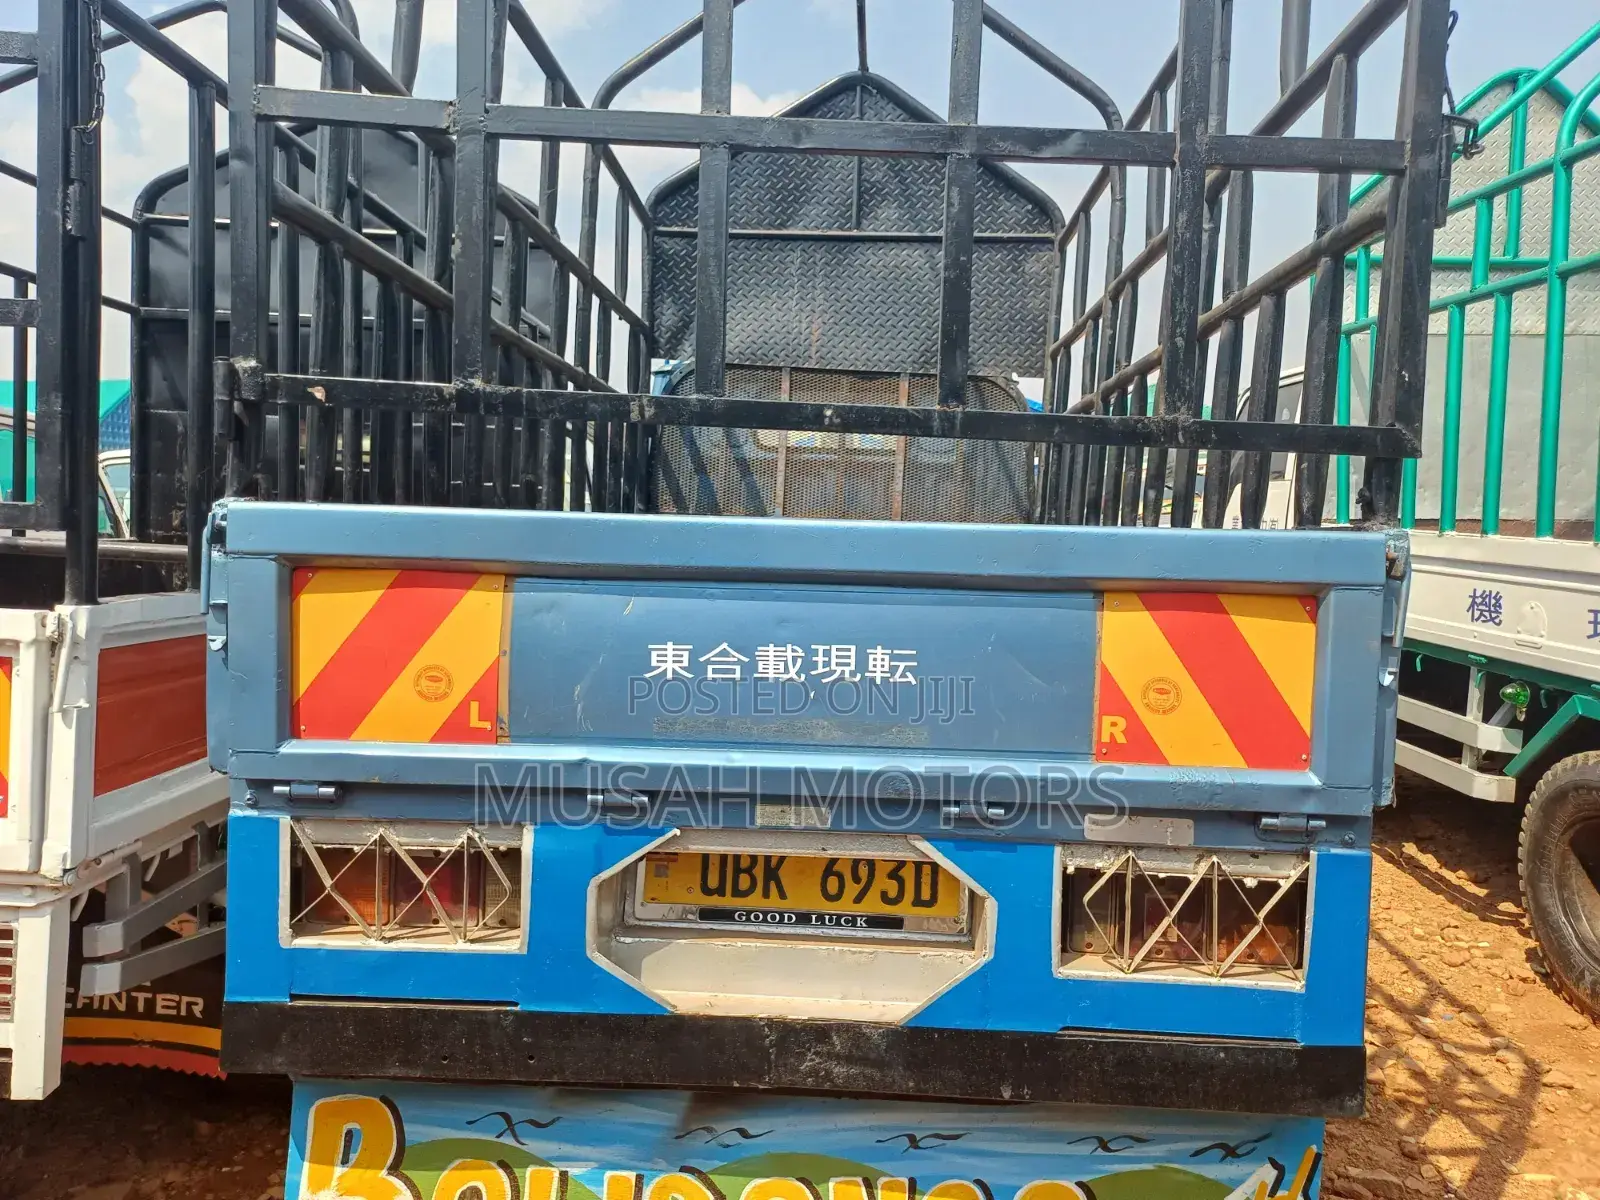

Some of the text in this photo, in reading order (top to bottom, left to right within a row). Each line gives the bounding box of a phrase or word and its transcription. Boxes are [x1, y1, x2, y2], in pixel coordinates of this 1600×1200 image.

[1467, 588, 1503, 627] 機
[643, 641, 918, 686] 東合載現転
[469, 700, 491, 729] L
[1101, 715, 1128, 744] R
[700, 853, 939, 909] UBK 693D
[734, 911, 870, 929] GOOD LUCK
